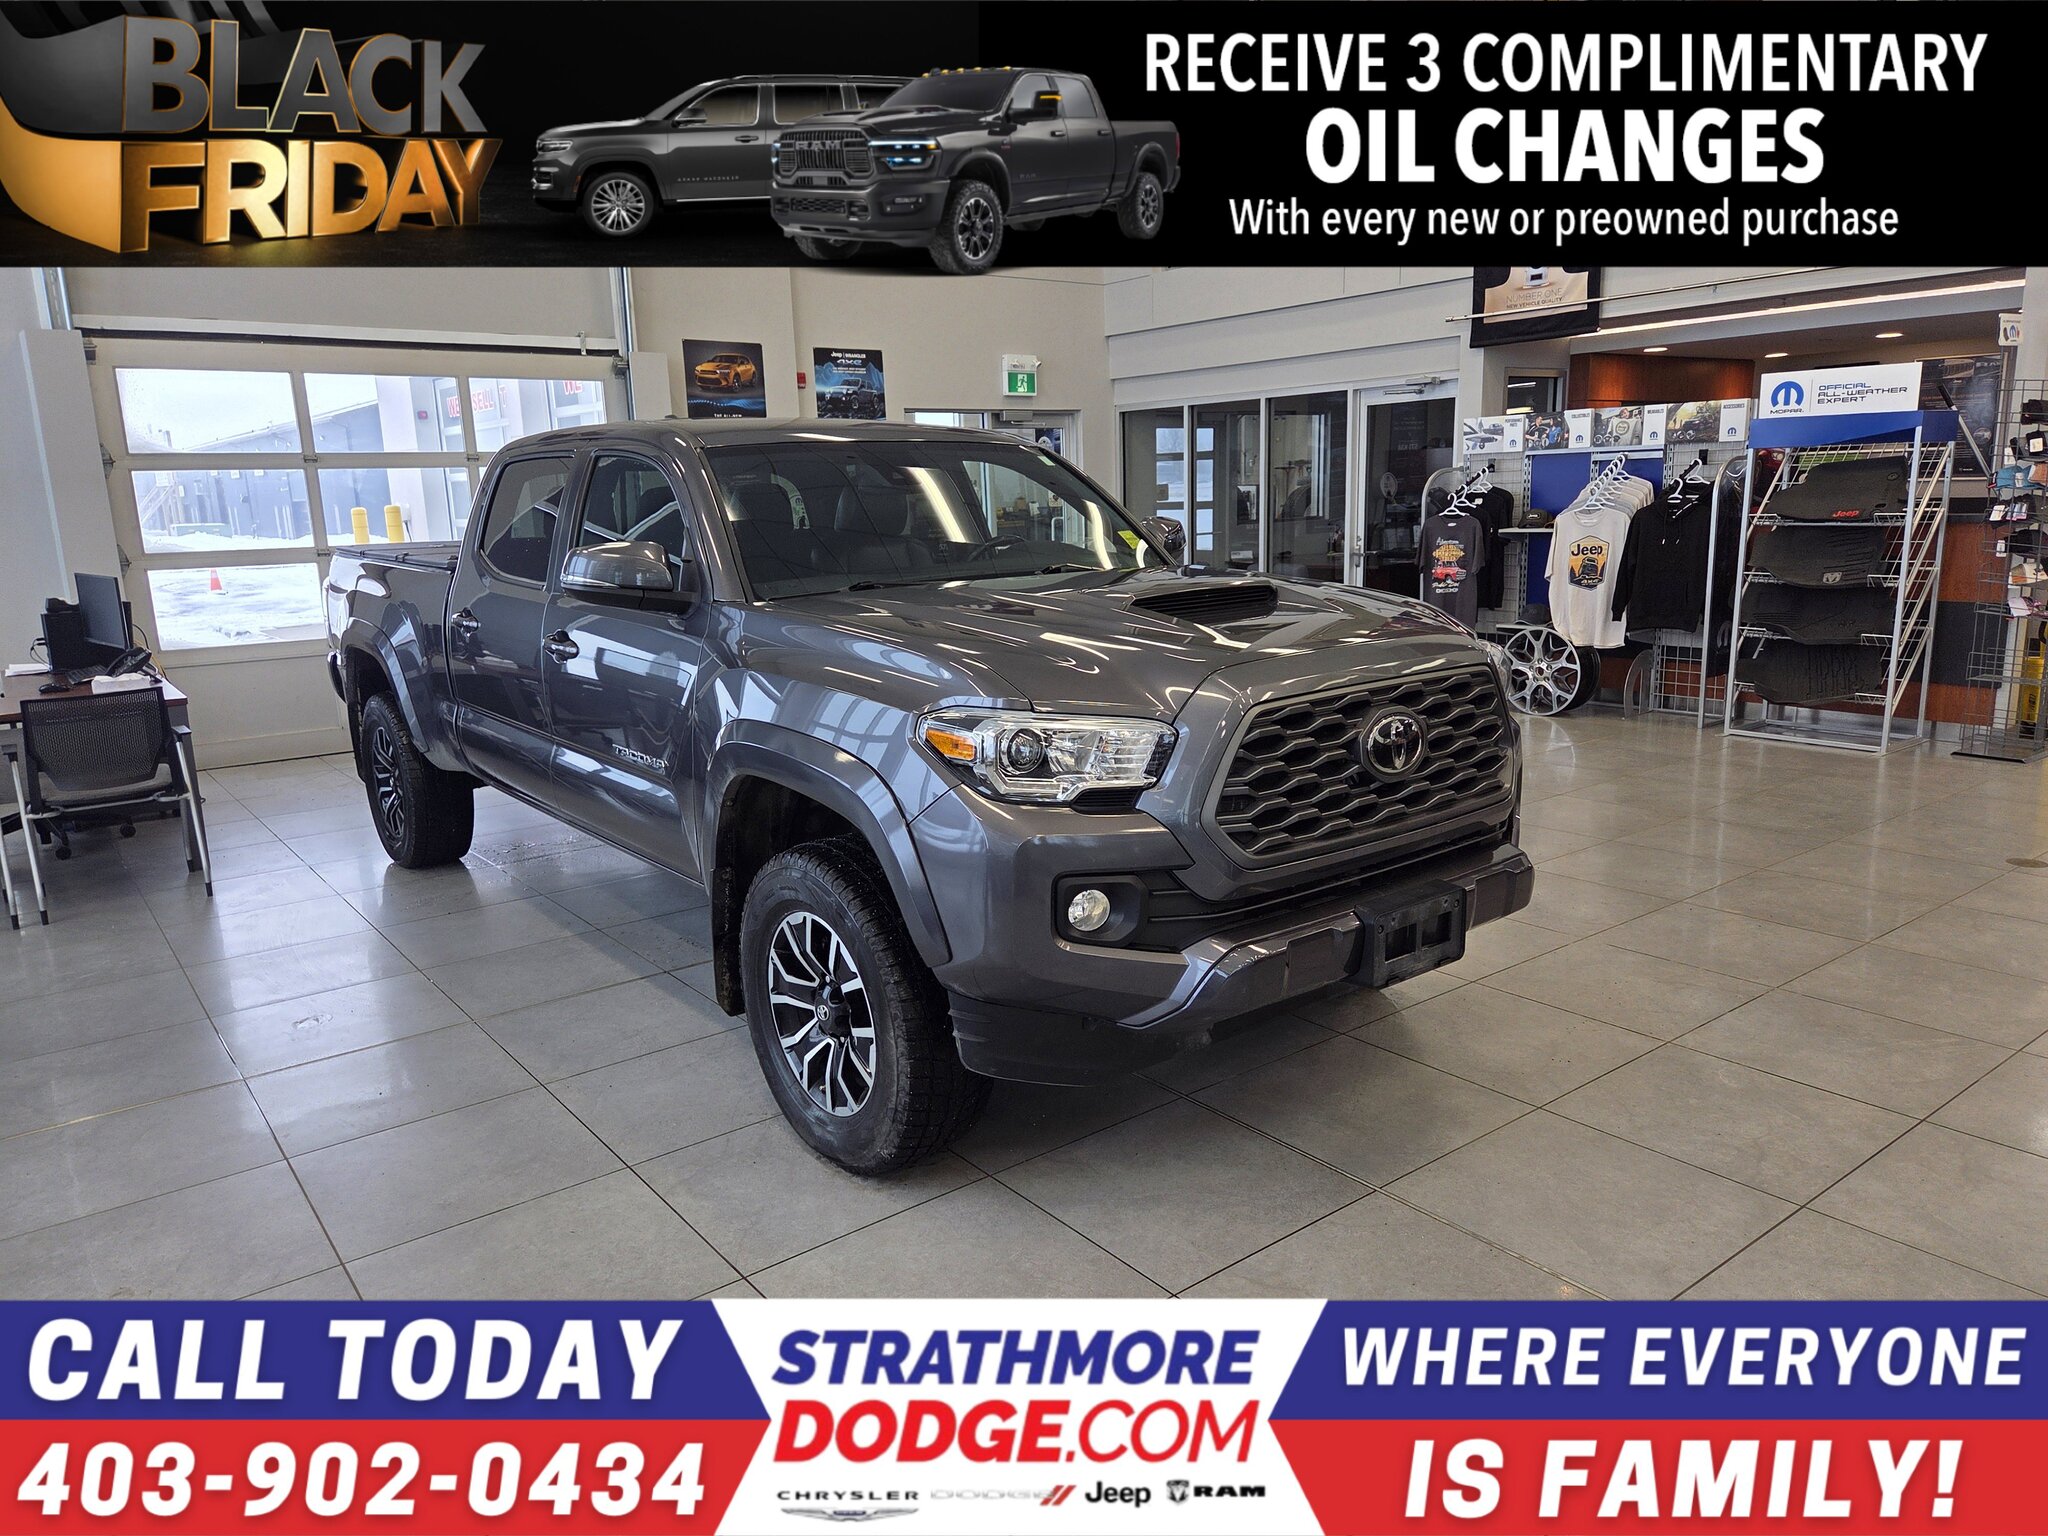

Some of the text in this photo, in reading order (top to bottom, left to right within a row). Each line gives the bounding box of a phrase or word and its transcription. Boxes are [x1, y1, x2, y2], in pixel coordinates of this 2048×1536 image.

[1505, 287, 1564, 304] NUMBER ONE
[1817, 386, 1908, 398] ALL-WEATHER
[1818, 382, 1872, 391] OFFICIAL
[1817, 395, 1867, 405] EXPERT
[1833, 510, 1860, 518] Jeep
[1570, 543, 1603, 557] Jeep
[611, 743, 670, 769] TACOMA
